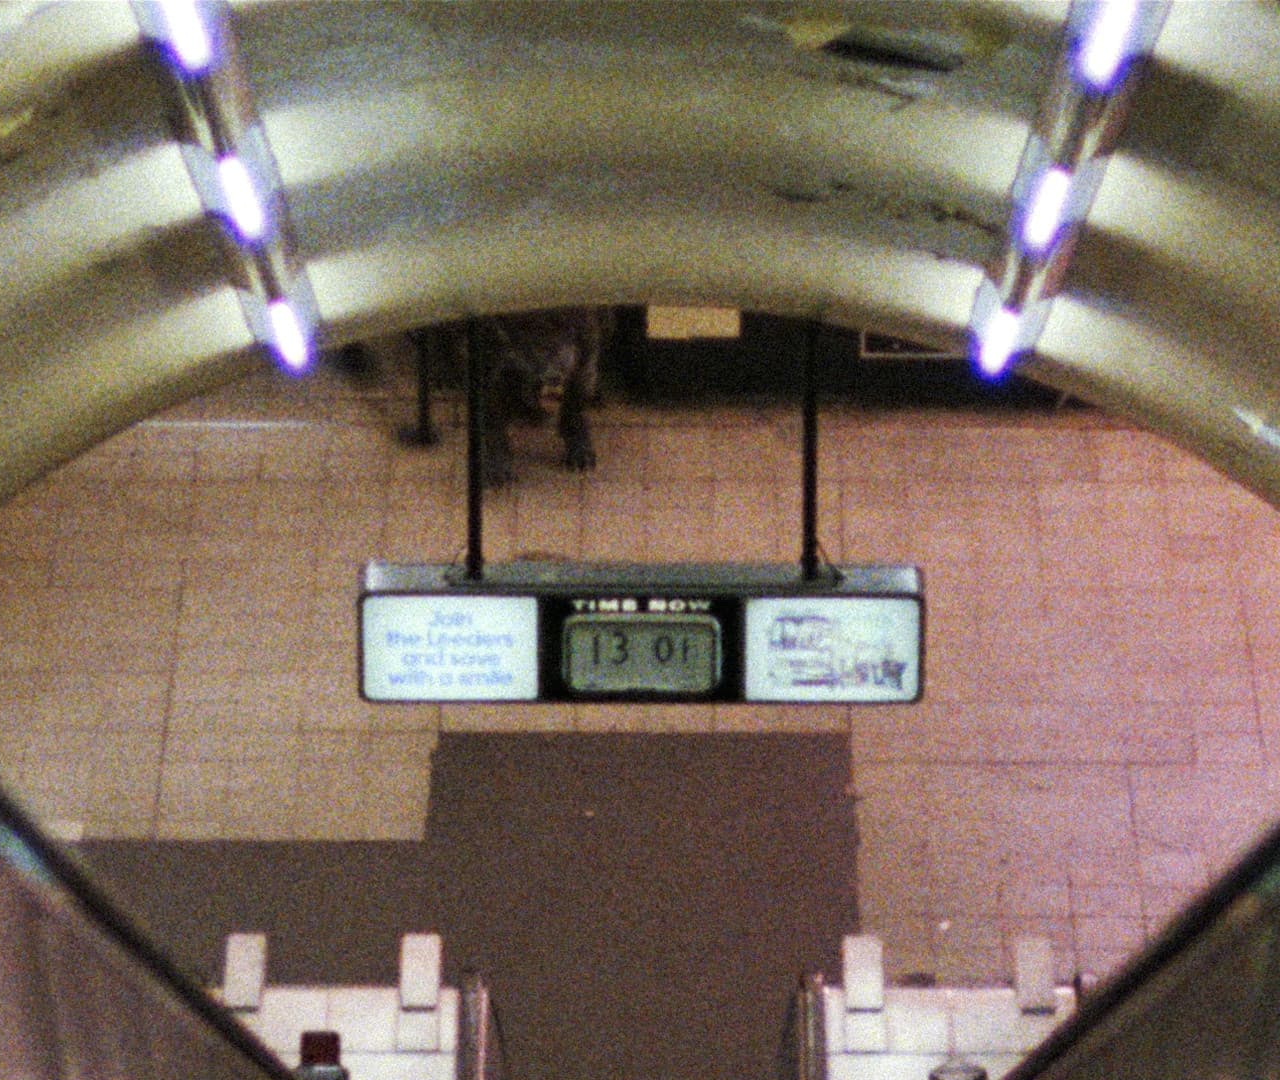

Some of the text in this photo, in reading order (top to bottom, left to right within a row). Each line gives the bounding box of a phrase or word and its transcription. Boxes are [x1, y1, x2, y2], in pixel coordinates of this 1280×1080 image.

[573, 599, 712, 612] TIME NOW
[429, 610, 473, 627] Join
[386, 631, 421, 647] the
[592, 630, 629, 666] 13
[401, 648, 502, 667] and save
[388, 669, 514, 686] with a smile
